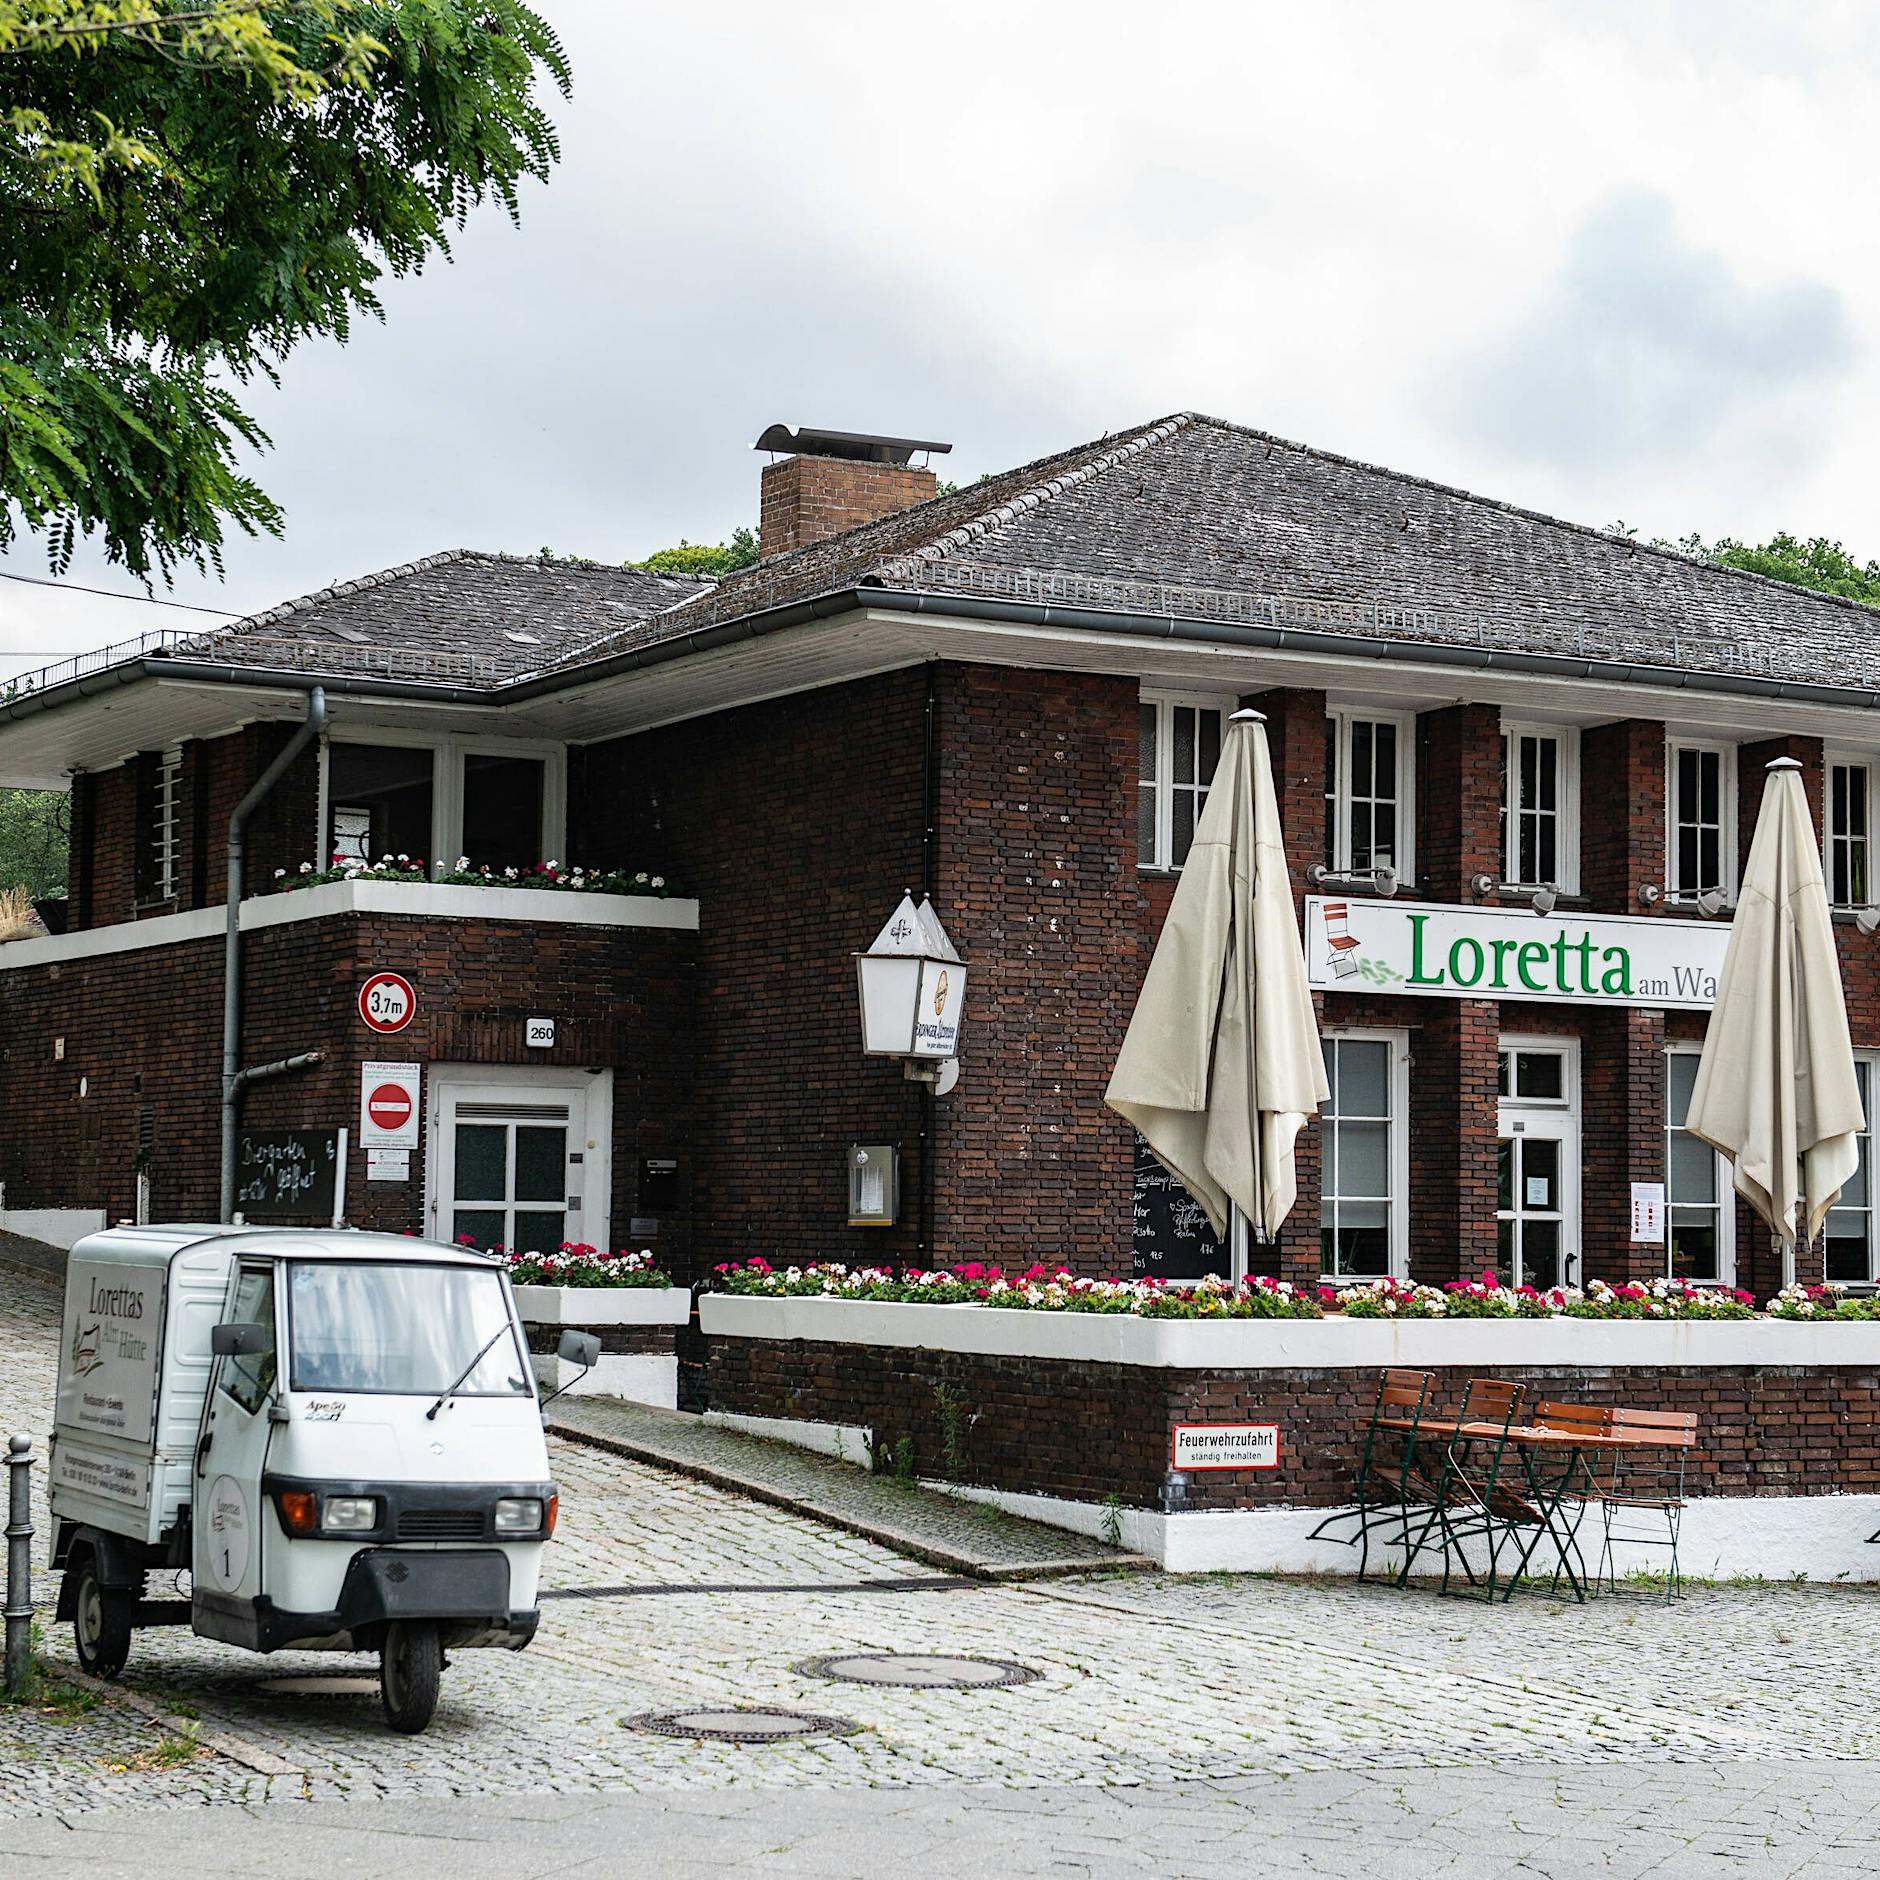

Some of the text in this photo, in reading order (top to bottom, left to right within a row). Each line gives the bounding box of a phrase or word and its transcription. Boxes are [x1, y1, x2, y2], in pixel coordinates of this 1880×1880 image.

[1406, 914, 1716, 999] Loretta am Wa
[531, 1027, 554, 1039] 260
[89, 1276, 144, 1319] Lorettas
[1179, 1431, 1273, 1447] Feuerwehrzufahrt
[1191, 1451, 1262, 1463] ständig freihalten
[223, 1547, 231, 1577] 1
